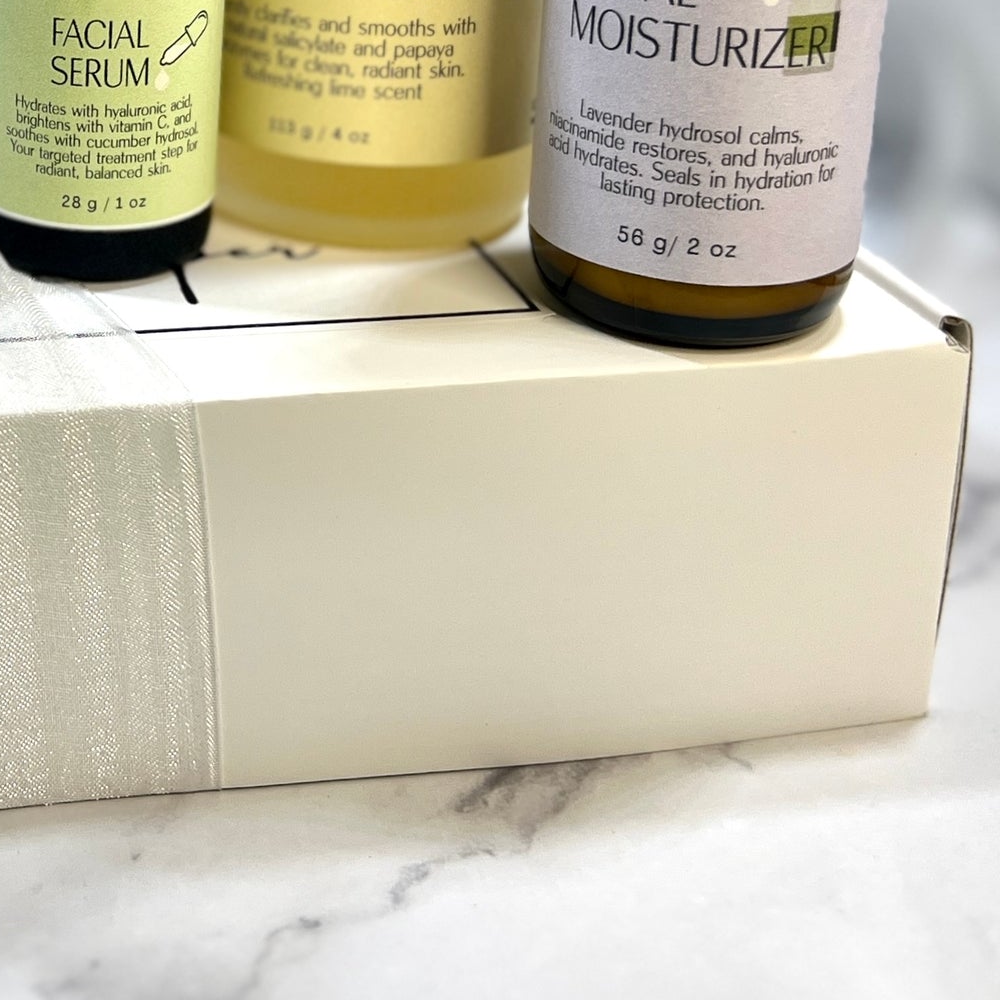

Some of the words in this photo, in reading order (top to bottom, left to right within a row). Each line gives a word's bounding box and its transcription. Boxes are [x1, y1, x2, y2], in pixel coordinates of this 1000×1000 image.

[52, 16, 150, 50] FACIAL
[318, 16, 351, 34] and
[358, 18, 435, 37] smooths
[443, 16, 476, 36] with
[353, 39, 387, 58] and
[393, 43, 454, 61] papaya
[51, 55, 150, 88] SERUM
[277, 48, 298, 68] for
[362, 60, 422, 80] radiant
[429, 60, 465, 79] skin.
[329, 79, 366, 99] lime
[374, 83, 423, 101] scent
[15, 92, 67, 115] Hydrates
[71, 103, 99, 118] with
[104, 101, 167, 120] hyaluronic
[16, 109, 71, 131] brightens
[76, 119, 104, 133] with
[109, 118, 153, 133] vitamin
[173, 108, 192, 126] and
[579, 98, 653, 134] Lavender
[659, 117, 742, 145] hydrosol
[749, 125, 804, 146] calms,
[6, 125, 50, 144] soothes
[54, 133, 81, 147] with
[86, 134, 151, 149] cucumber
[333, 127, 342, 140] 4
[347, 130, 370, 144] oz
[549, 109, 626, 151] niacinamide
[632, 140, 712, 167] restores,
[721, 147, 757, 168] and
[763, 141, 839, 170] hyaluronic
[9, 138, 35, 156] Your
[39, 146, 91, 165] targeted
[96, 149, 156, 165] treatment
[161, 145, 184, 160] step
[186, 138, 198, 153] for
[548, 132, 570, 155] acid
[574, 140, 643, 178] hydrates.
[651, 160, 701, 187] Seals
[709, 170, 726, 189] in
[734, 169, 812, 194] hydration
[817, 163, 836, 184] for
[35, 162, 80, 180] radiant,
[85, 164, 143, 180] balanced
[147, 161, 172, 177] skin.
[61, 194, 81, 209] 28
[87, 199, 97, 213] g
[103, 197, 110, 213] /
[115, 196, 123, 210] 1
[129, 197, 147, 209] oz
[600, 171, 656, 206] lasting
[663, 190, 765, 212] protection.
[617, 225, 644, 247] 56
[687, 237, 701, 256] 2
[710, 243, 737, 259] oz
